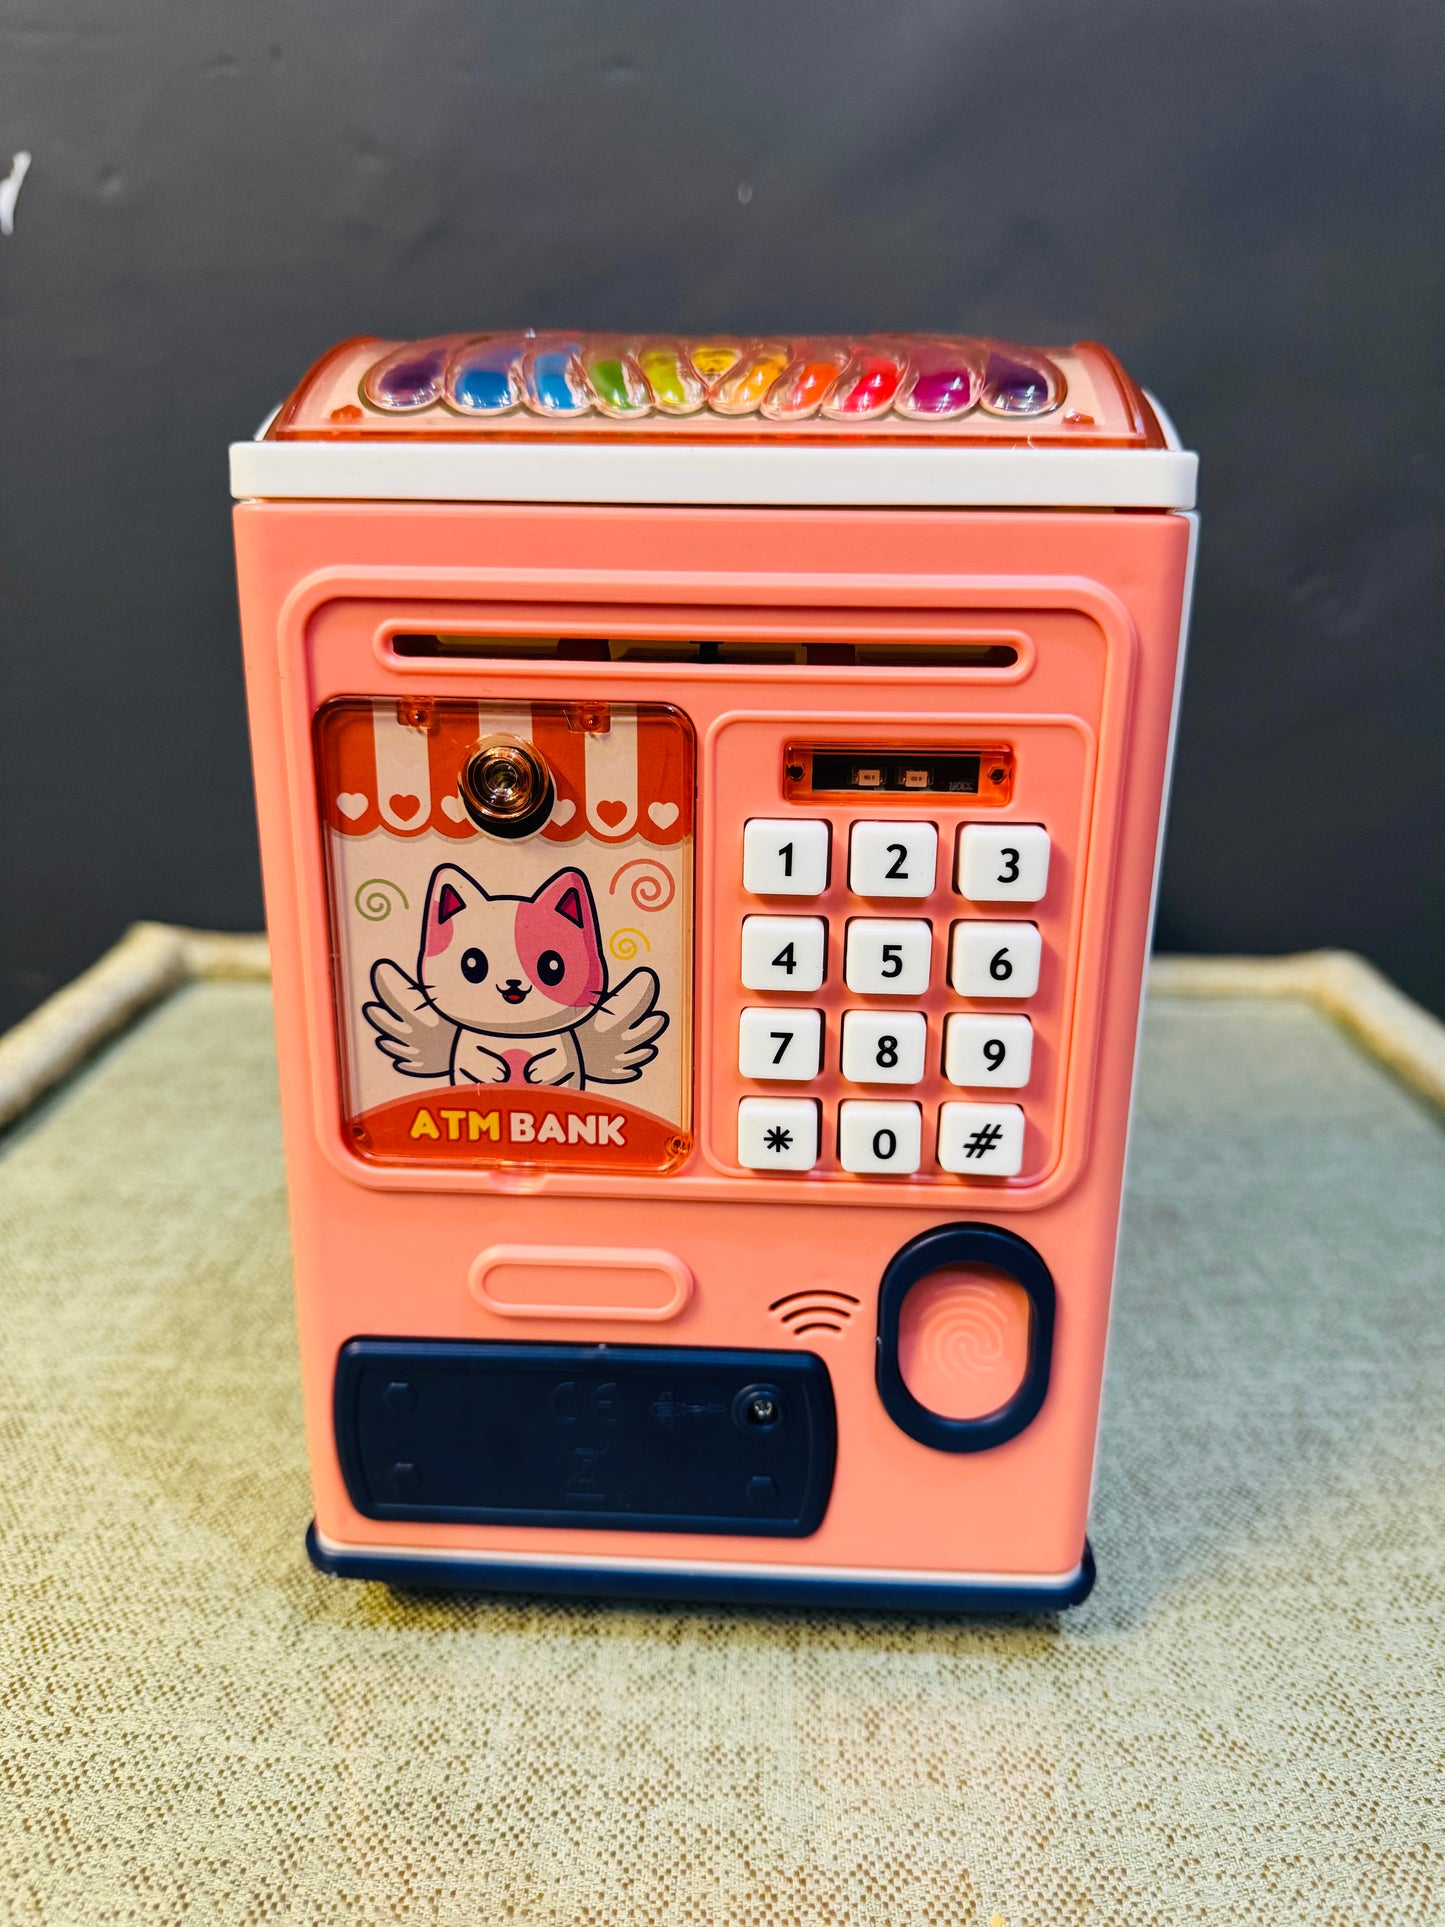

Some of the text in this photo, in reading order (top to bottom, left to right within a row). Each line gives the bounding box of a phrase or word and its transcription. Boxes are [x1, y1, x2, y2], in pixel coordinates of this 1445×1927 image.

[779, 843, 1019, 883] 1 2 3
[772, 942, 1012, 980] 4 5 6
[771, 1032, 1005, 1071] 7 8 9
[410, 1109, 626, 1146] ATM BANK
[873, 1129, 896, 1159] 0
[963, 1124, 1003, 1158] #
